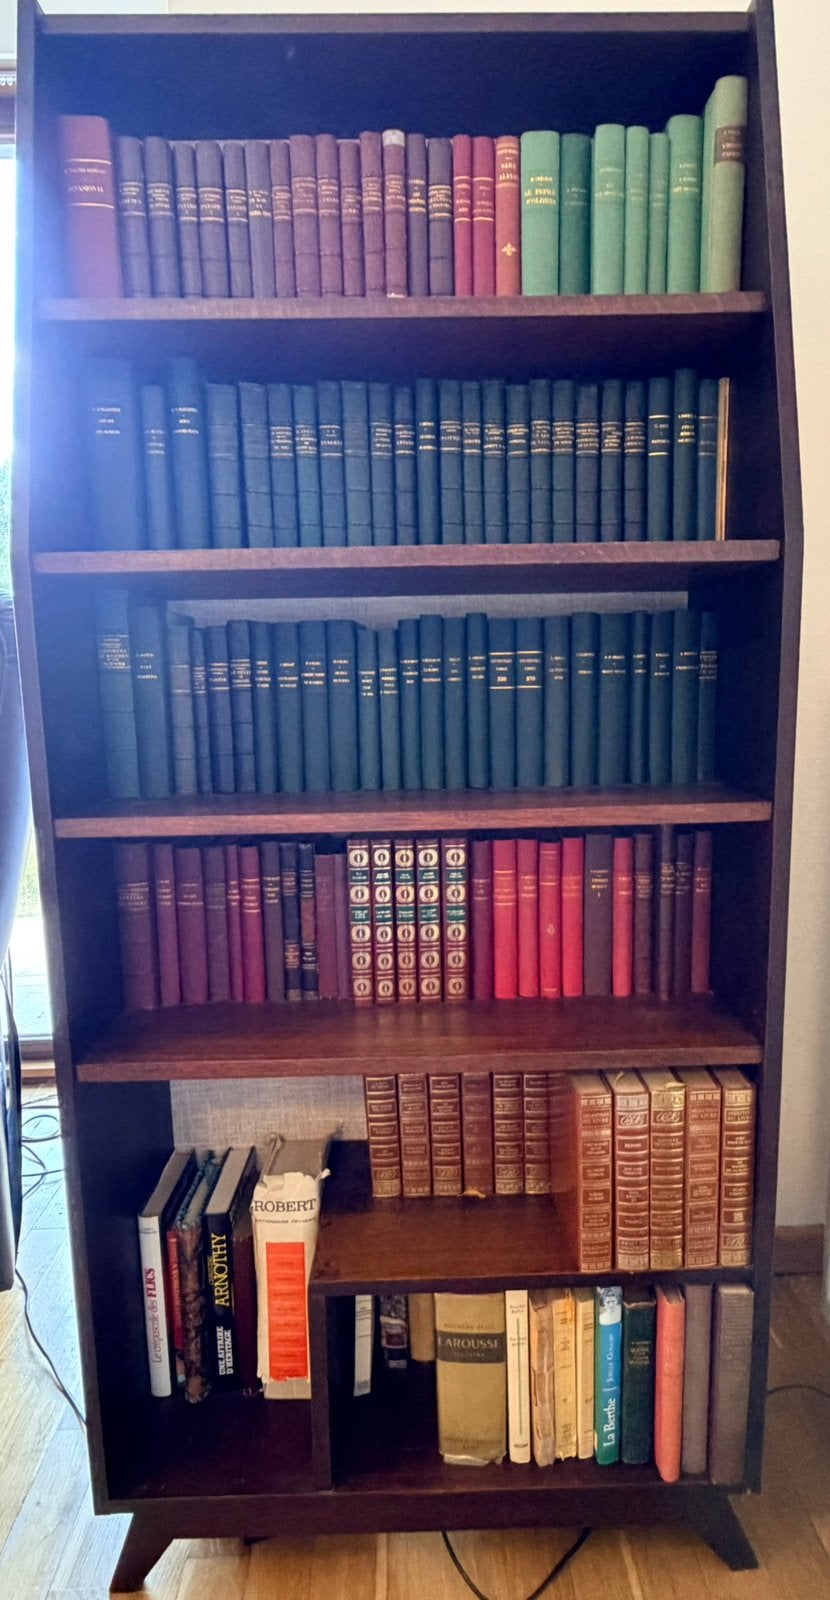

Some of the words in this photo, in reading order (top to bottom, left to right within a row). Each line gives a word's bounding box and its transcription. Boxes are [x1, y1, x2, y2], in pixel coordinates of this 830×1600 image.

[254, 1198, 317, 1213] ROBERT
[211, 1232, 230, 1307] ARNOTHY
[144, 1267, 157, 1298] FLICS
[216, 1326, 225, 1359] AFFAIRE
[152, 1352, 163, 1363] Le
[218, 1359, 226, 1376] UNE
[603, 1397, 616, 1432] Berthe
[603, 1433, 615, 1447] La
